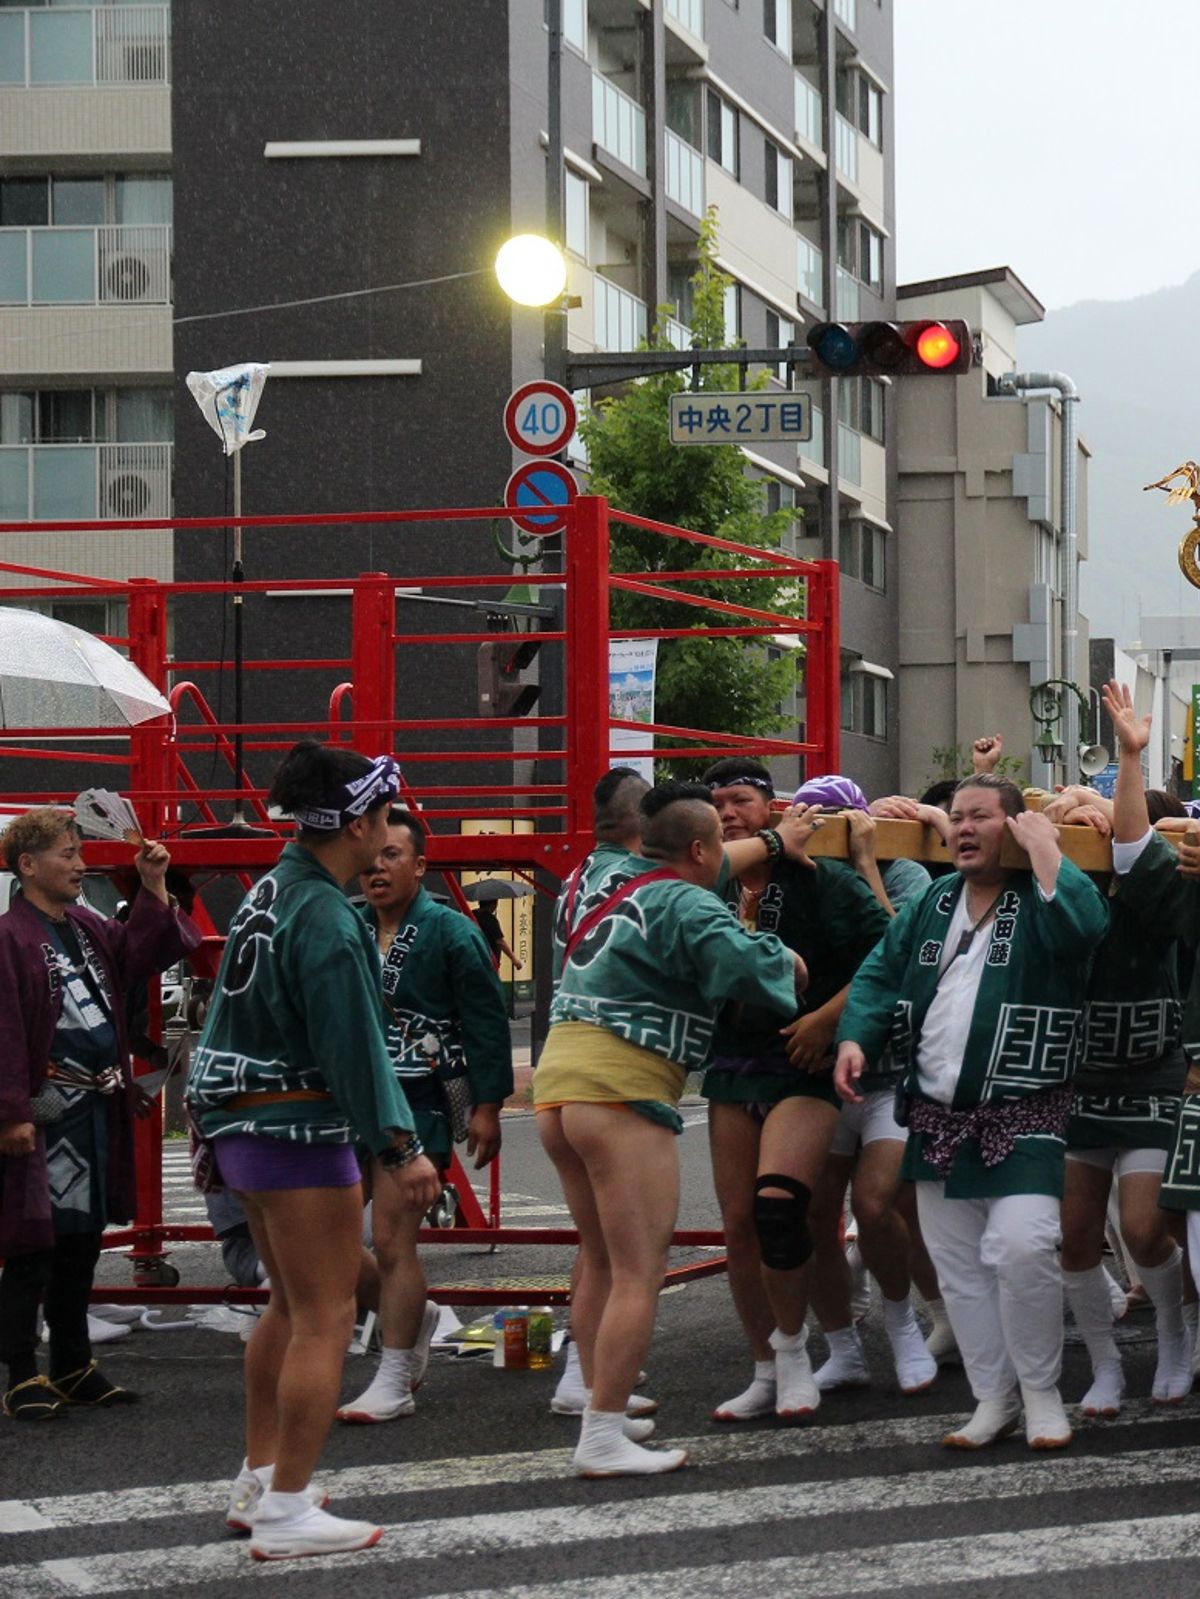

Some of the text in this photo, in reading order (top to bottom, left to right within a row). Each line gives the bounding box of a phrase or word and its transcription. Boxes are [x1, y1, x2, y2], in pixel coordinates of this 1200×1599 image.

[522, 402, 562, 436] 40
[678, 402, 803, 434] 中央2丁目
